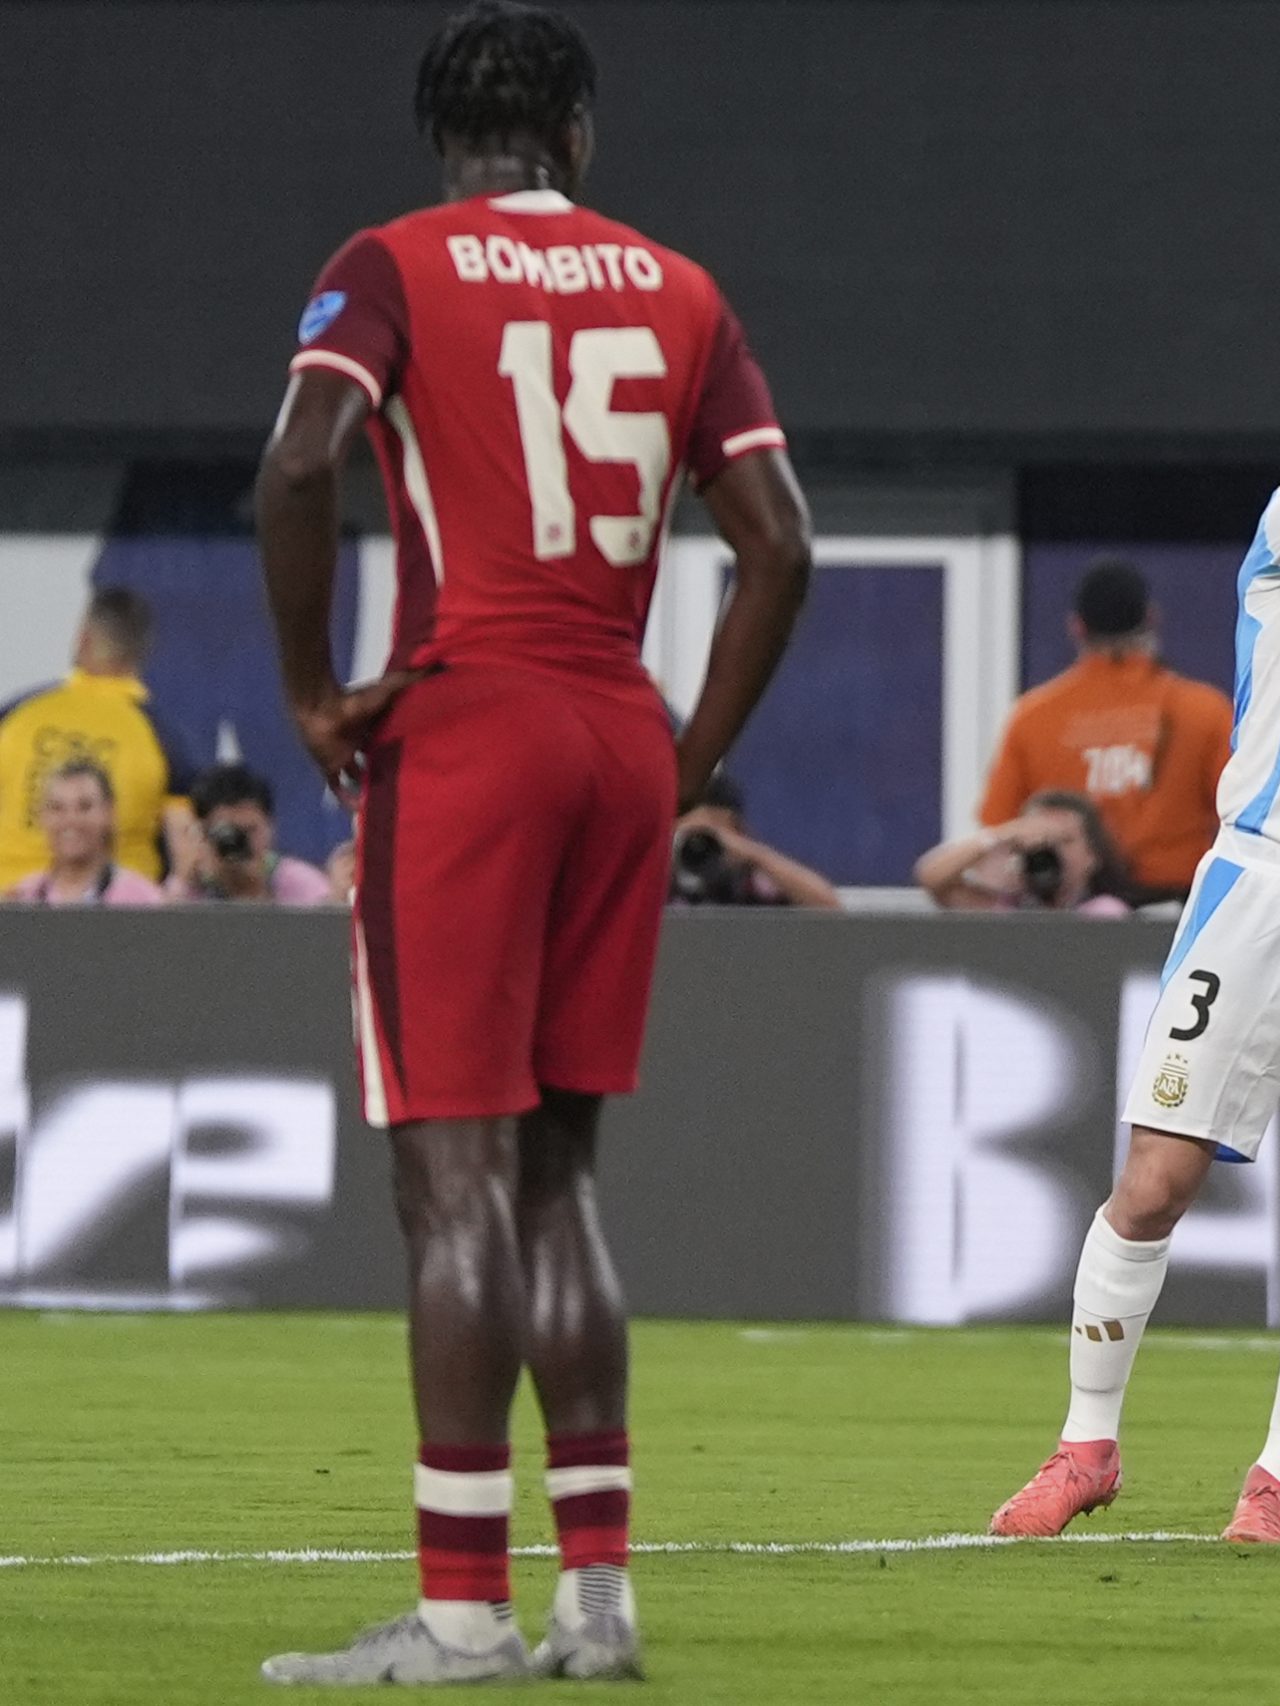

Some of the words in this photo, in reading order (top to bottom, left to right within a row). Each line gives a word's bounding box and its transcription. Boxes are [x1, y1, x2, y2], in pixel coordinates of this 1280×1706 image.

[447, 233, 663, 294] BOMBITO
[497, 319, 671, 567] 15
[1168, 968, 1221, 1042] 3
